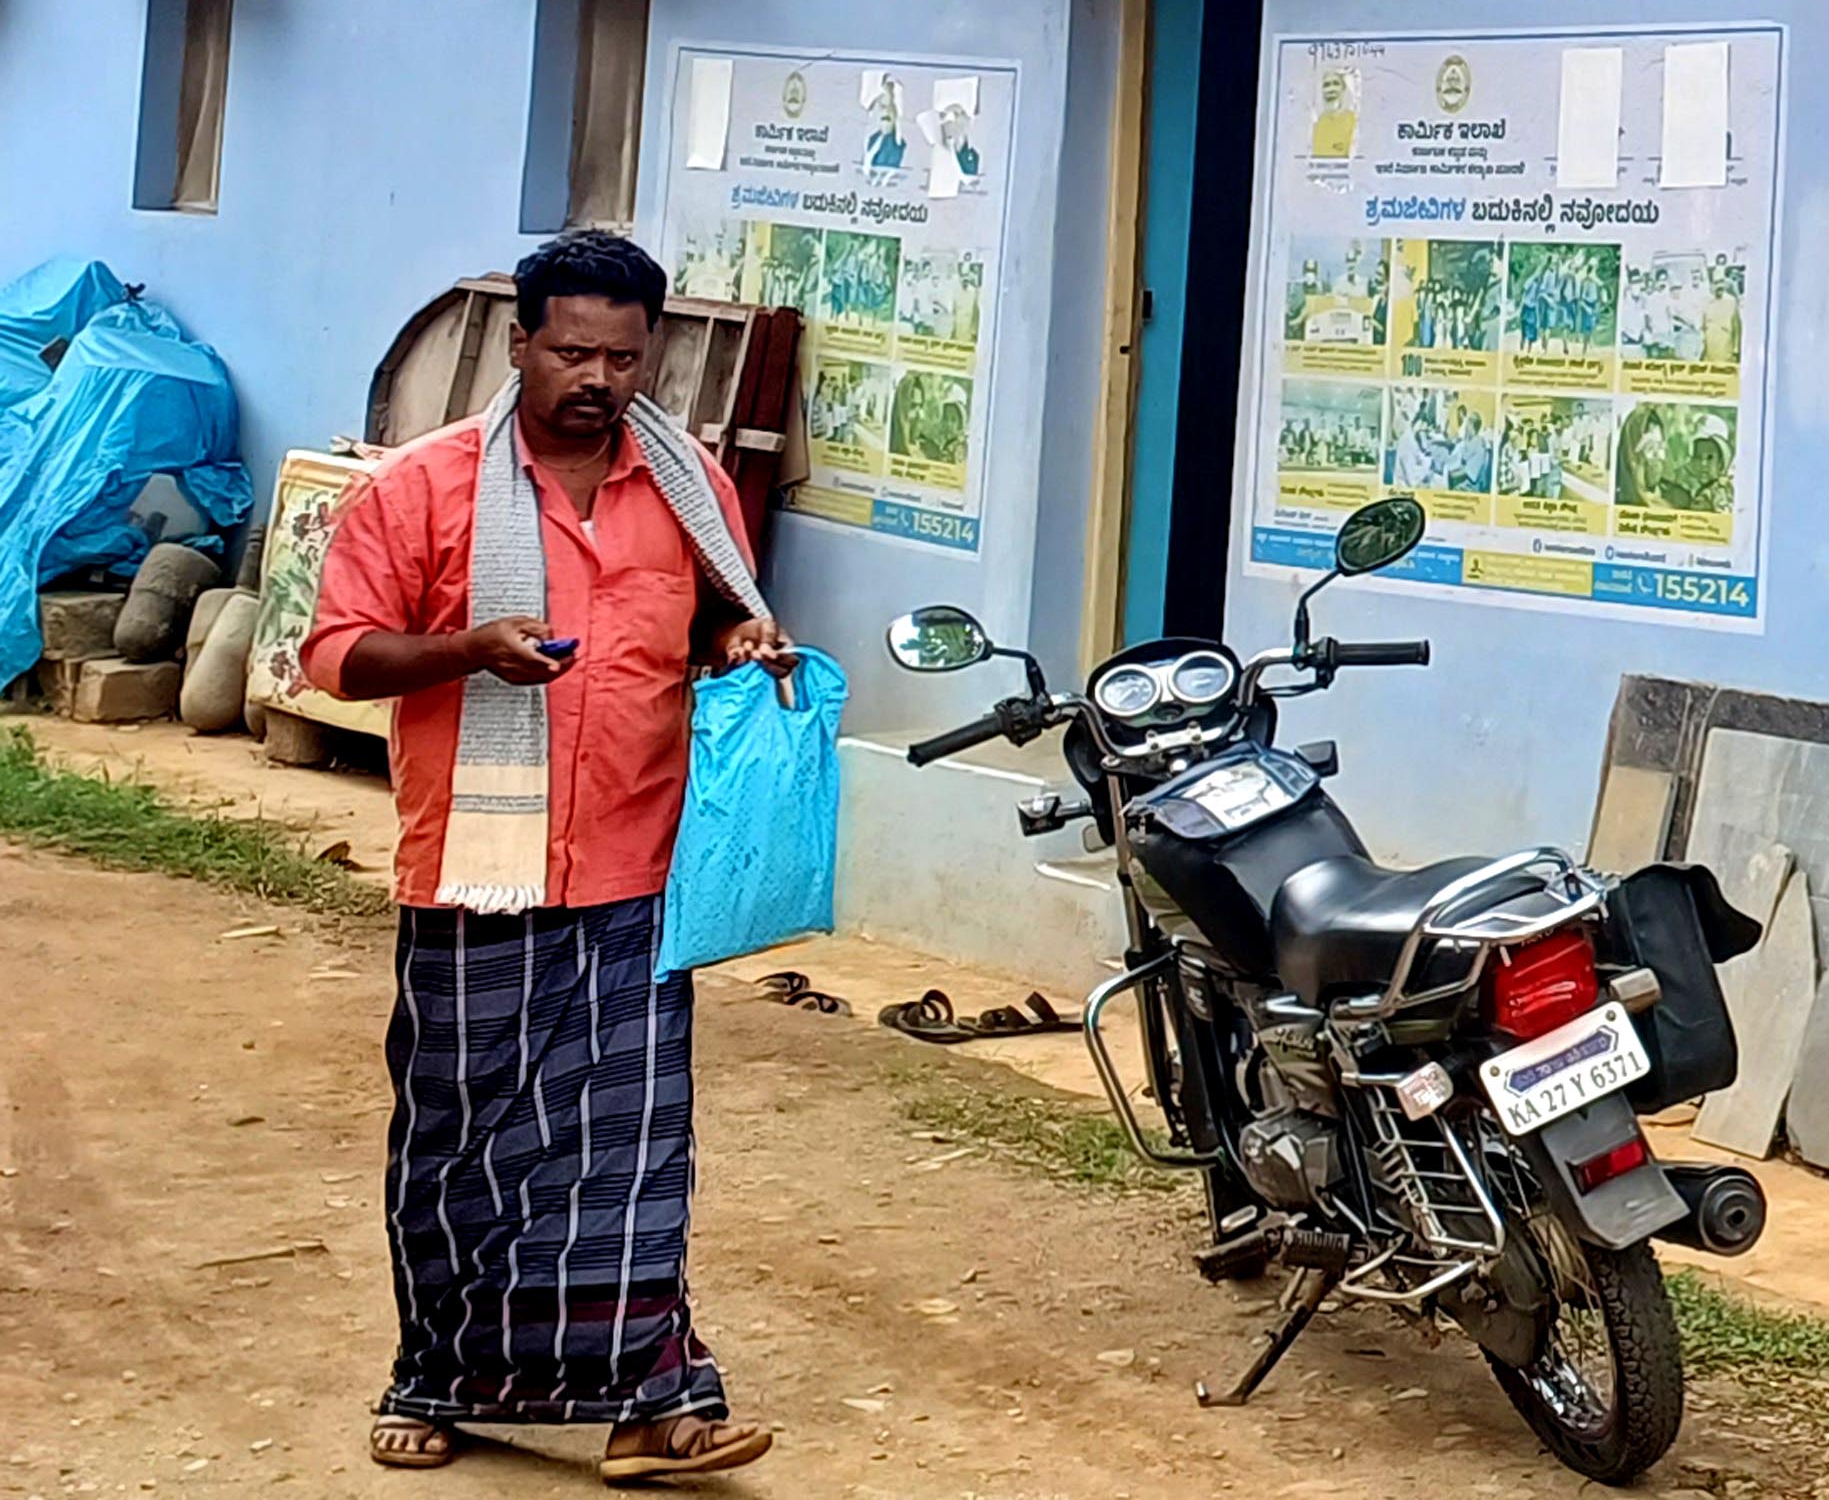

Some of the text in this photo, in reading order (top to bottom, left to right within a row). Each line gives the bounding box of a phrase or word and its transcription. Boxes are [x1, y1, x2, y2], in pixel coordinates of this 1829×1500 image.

[1397, 118, 1507, 142] ಕಾರ್ಮಿಕ ಇಲಾಖೆ
[1471, 192, 1556, 234] ಬದುಕಿನಲ್ಲಿ
[1559, 197, 1660, 230] ನವೋದಯ
[912, 511, 975, 544] 155214
[1653, 572, 1750, 608] 155214
[1507, 1098, 1542, 1129] KA
[1540, 1083, 1568, 1112] 27
[1569, 1072, 1586, 1098] Y
[1590, 1051, 1643, 1089] 6371
